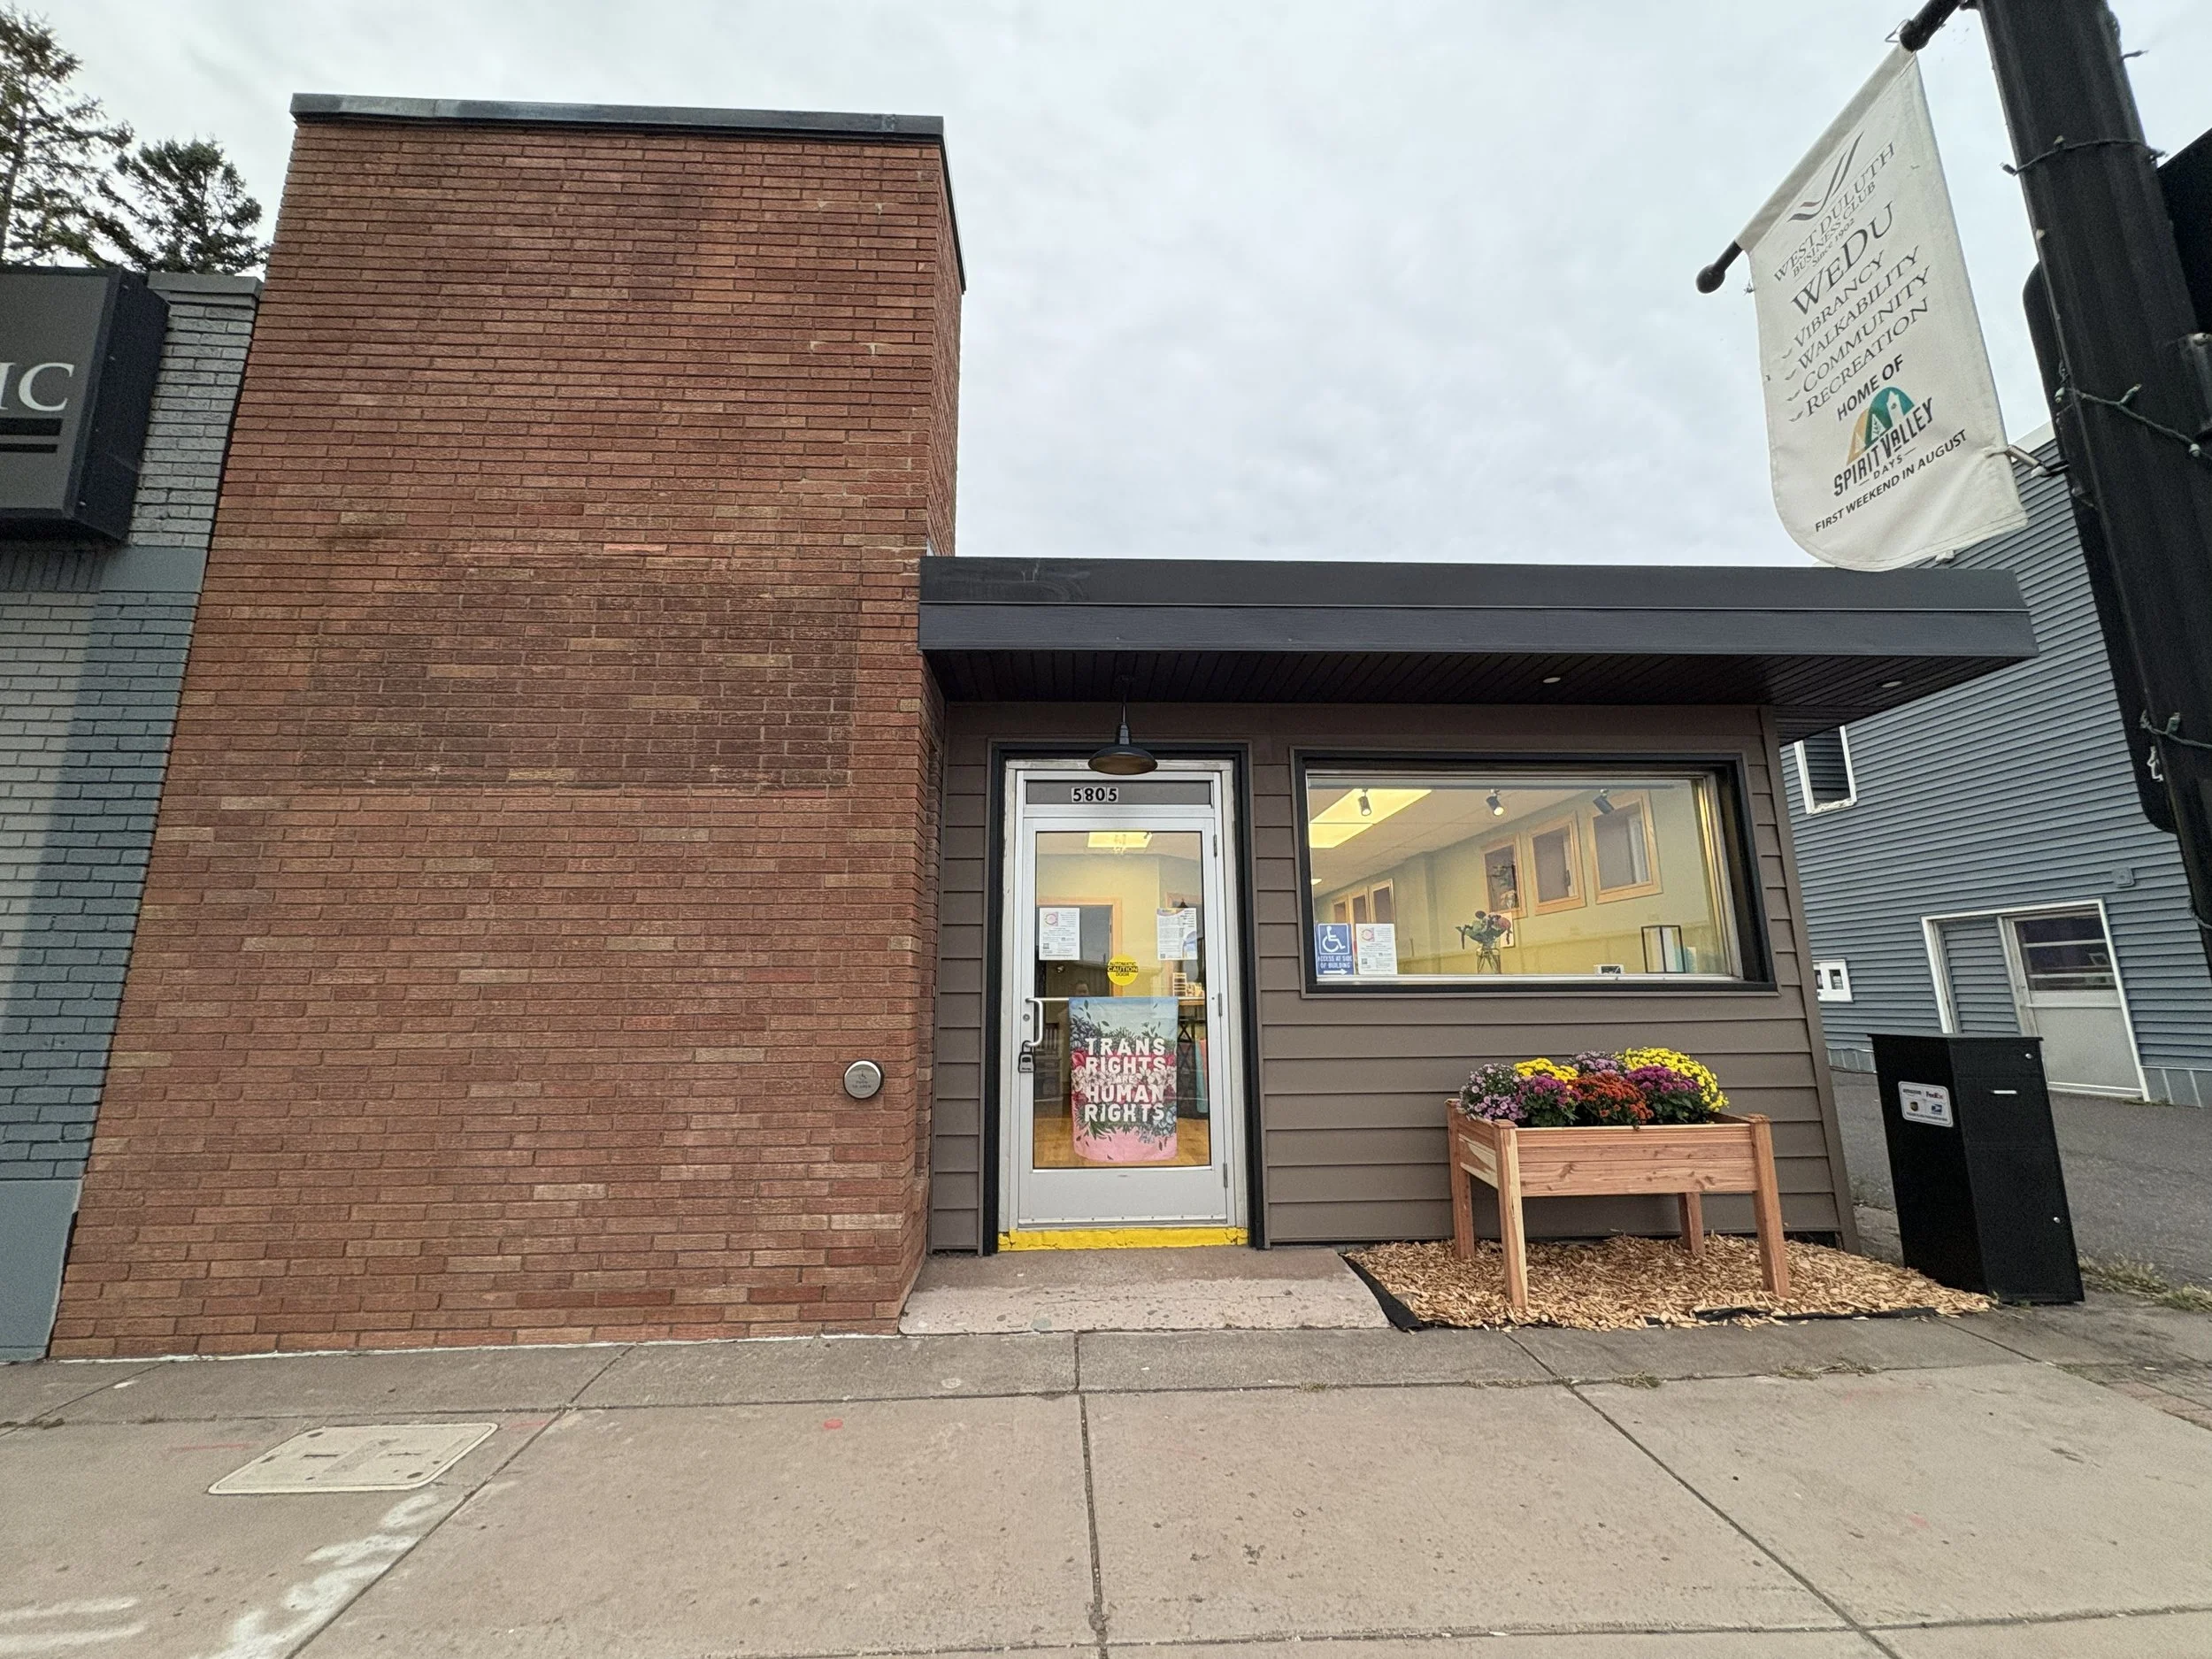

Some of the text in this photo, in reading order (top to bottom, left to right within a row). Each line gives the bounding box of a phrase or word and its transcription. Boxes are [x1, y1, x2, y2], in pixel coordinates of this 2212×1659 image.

[1773, 142, 1895, 282] WEST DULUTH
[1793, 181, 1876, 277] BUSINESS CLUB
[1812, 218, 1855, 267] Since 1902
[1793, 250, 1885, 348] VIBRANCY
[1798, 244, 1919, 369] WALKABILITY
[1803, 265, 1931, 393] COMMUNITY
[1806, 296, 1928, 417] RECREATION
[1837, 354, 1904, 421] HOME OF
[1833, 397, 1933, 496] SPIRIT VALLEY
[1873, 454, 1903, 480] DAYS
[1815, 429, 1967, 532] FIRST WEEKEND IN AUGUST
[1072, 787, 1118, 802] 5805
[1085, 1037, 1166, 1056] TRANS
[1085, 1056, 1167, 1074] RIGHTS
[1114, 1075, 1136, 1085] ARE
[1084, 1102, 1165, 1123] RIGHTS
[1085, 1084, 1165, 1103] HUMAN
